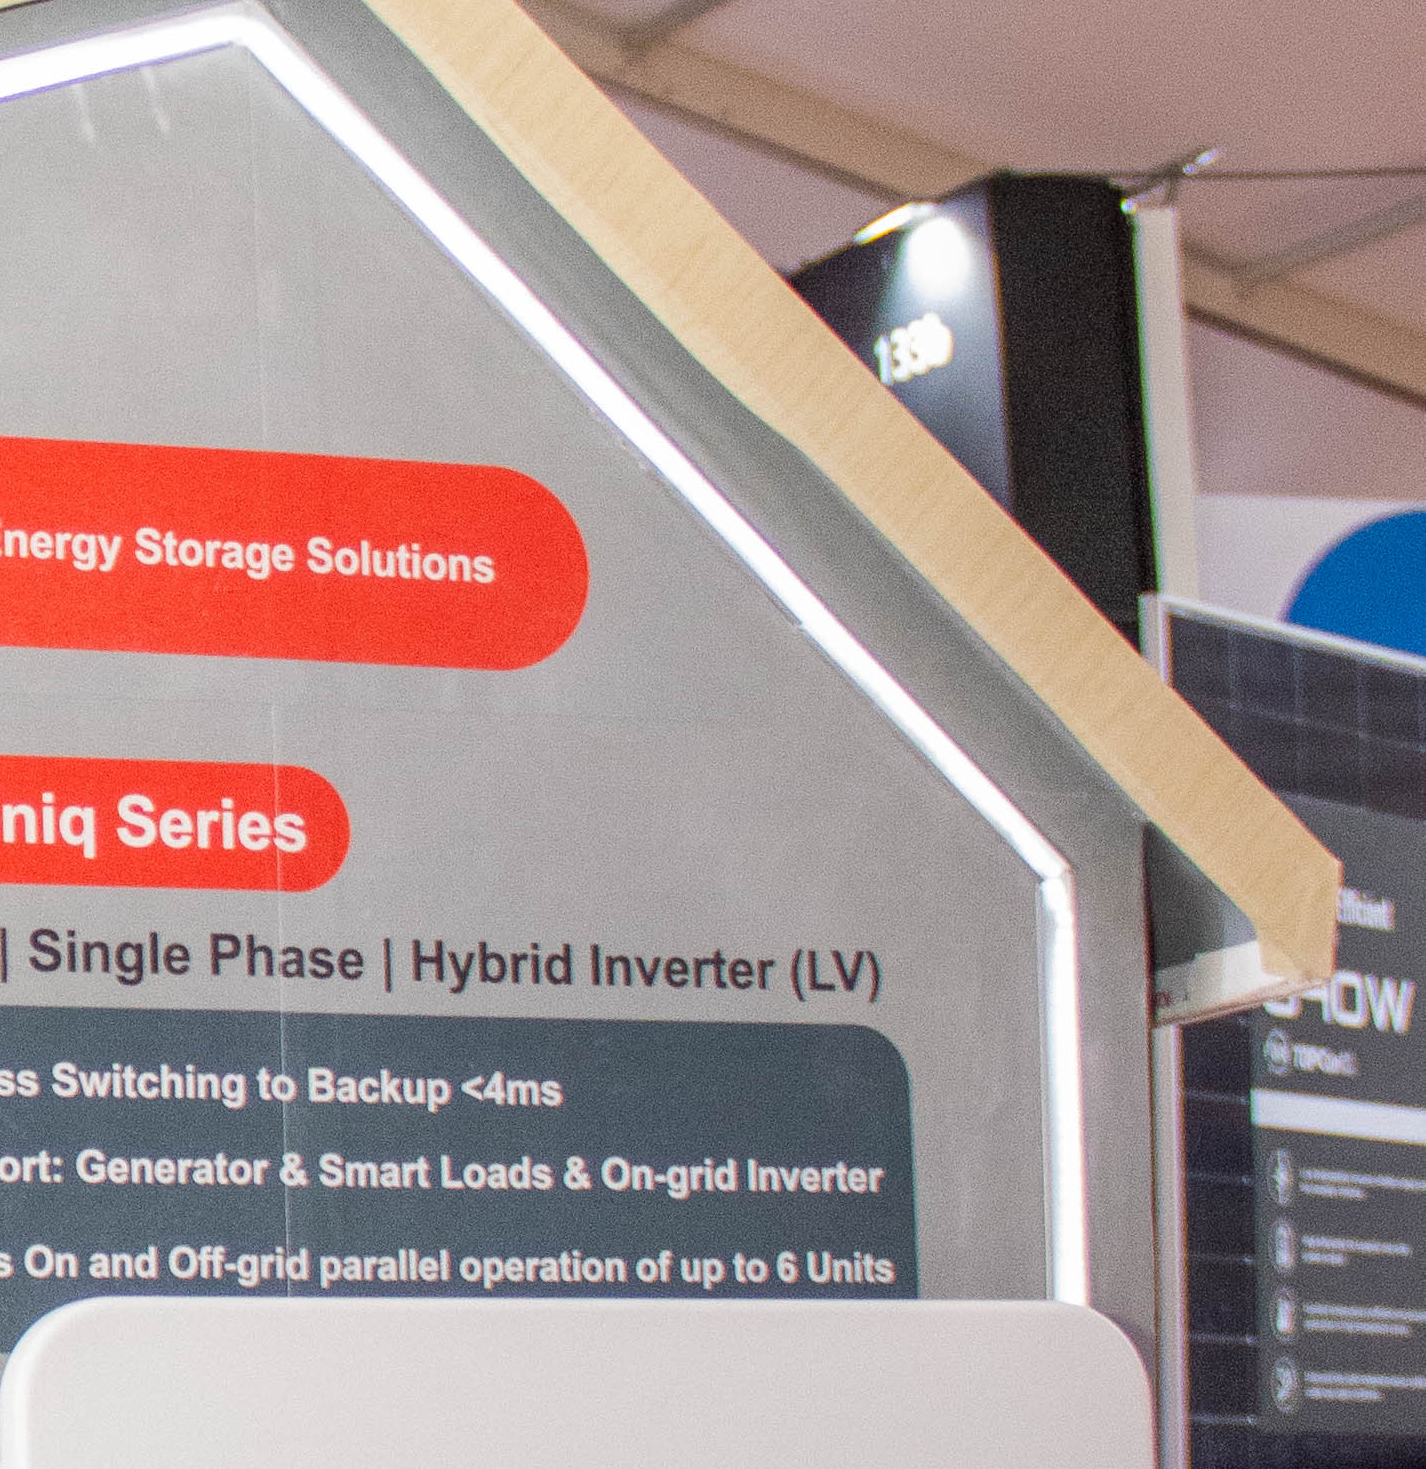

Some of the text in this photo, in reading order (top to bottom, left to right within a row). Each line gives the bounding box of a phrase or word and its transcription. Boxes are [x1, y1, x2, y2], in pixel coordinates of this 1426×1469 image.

[135, 527, 295, 579] Storage
[307, 537, 496, 584] Solutions
[116, 793, 307, 853] Series
[28, 928, 191, 987] Single
[210, 932, 365, 981] Phase
[412, 938, 574, 995] Hybrid
[591, 944, 775, 992] Inverter
[790, 947, 883, 1004] (LV)
[51, 1060, 246, 1110] Switching
[256, 1065, 297, 1102] to
[306, 1066, 451, 1114] Backup
[460, 1070, 564, 1108] <4ms
[75, 1148, 270, 1187] Generator
[279, 1152, 310, 1188] &
[318, 1153, 430, 1191] Smart
[440, 1154, 553, 1192] Loads
[563, 1155, 593, 1192] &
[600, 1155, 738, 1201] On-grid
[748, 1157, 886, 1194] Inverter
[23, 1244, 79, 1281] On
[88, 1245, 158, 1281] and
[168, 1243, 310, 1289] Off-grid
[319, 1248, 449, 1289] parallel
[459, 1249, 629, 1290] operation
[635, 1250, 675, 1285] of
[680, 1257, 725, 1291] up
[732, 1253, 770, 1284] to
[776, 1251, 799, 1284] 6
[806, 1250, 897, 1285] Units
